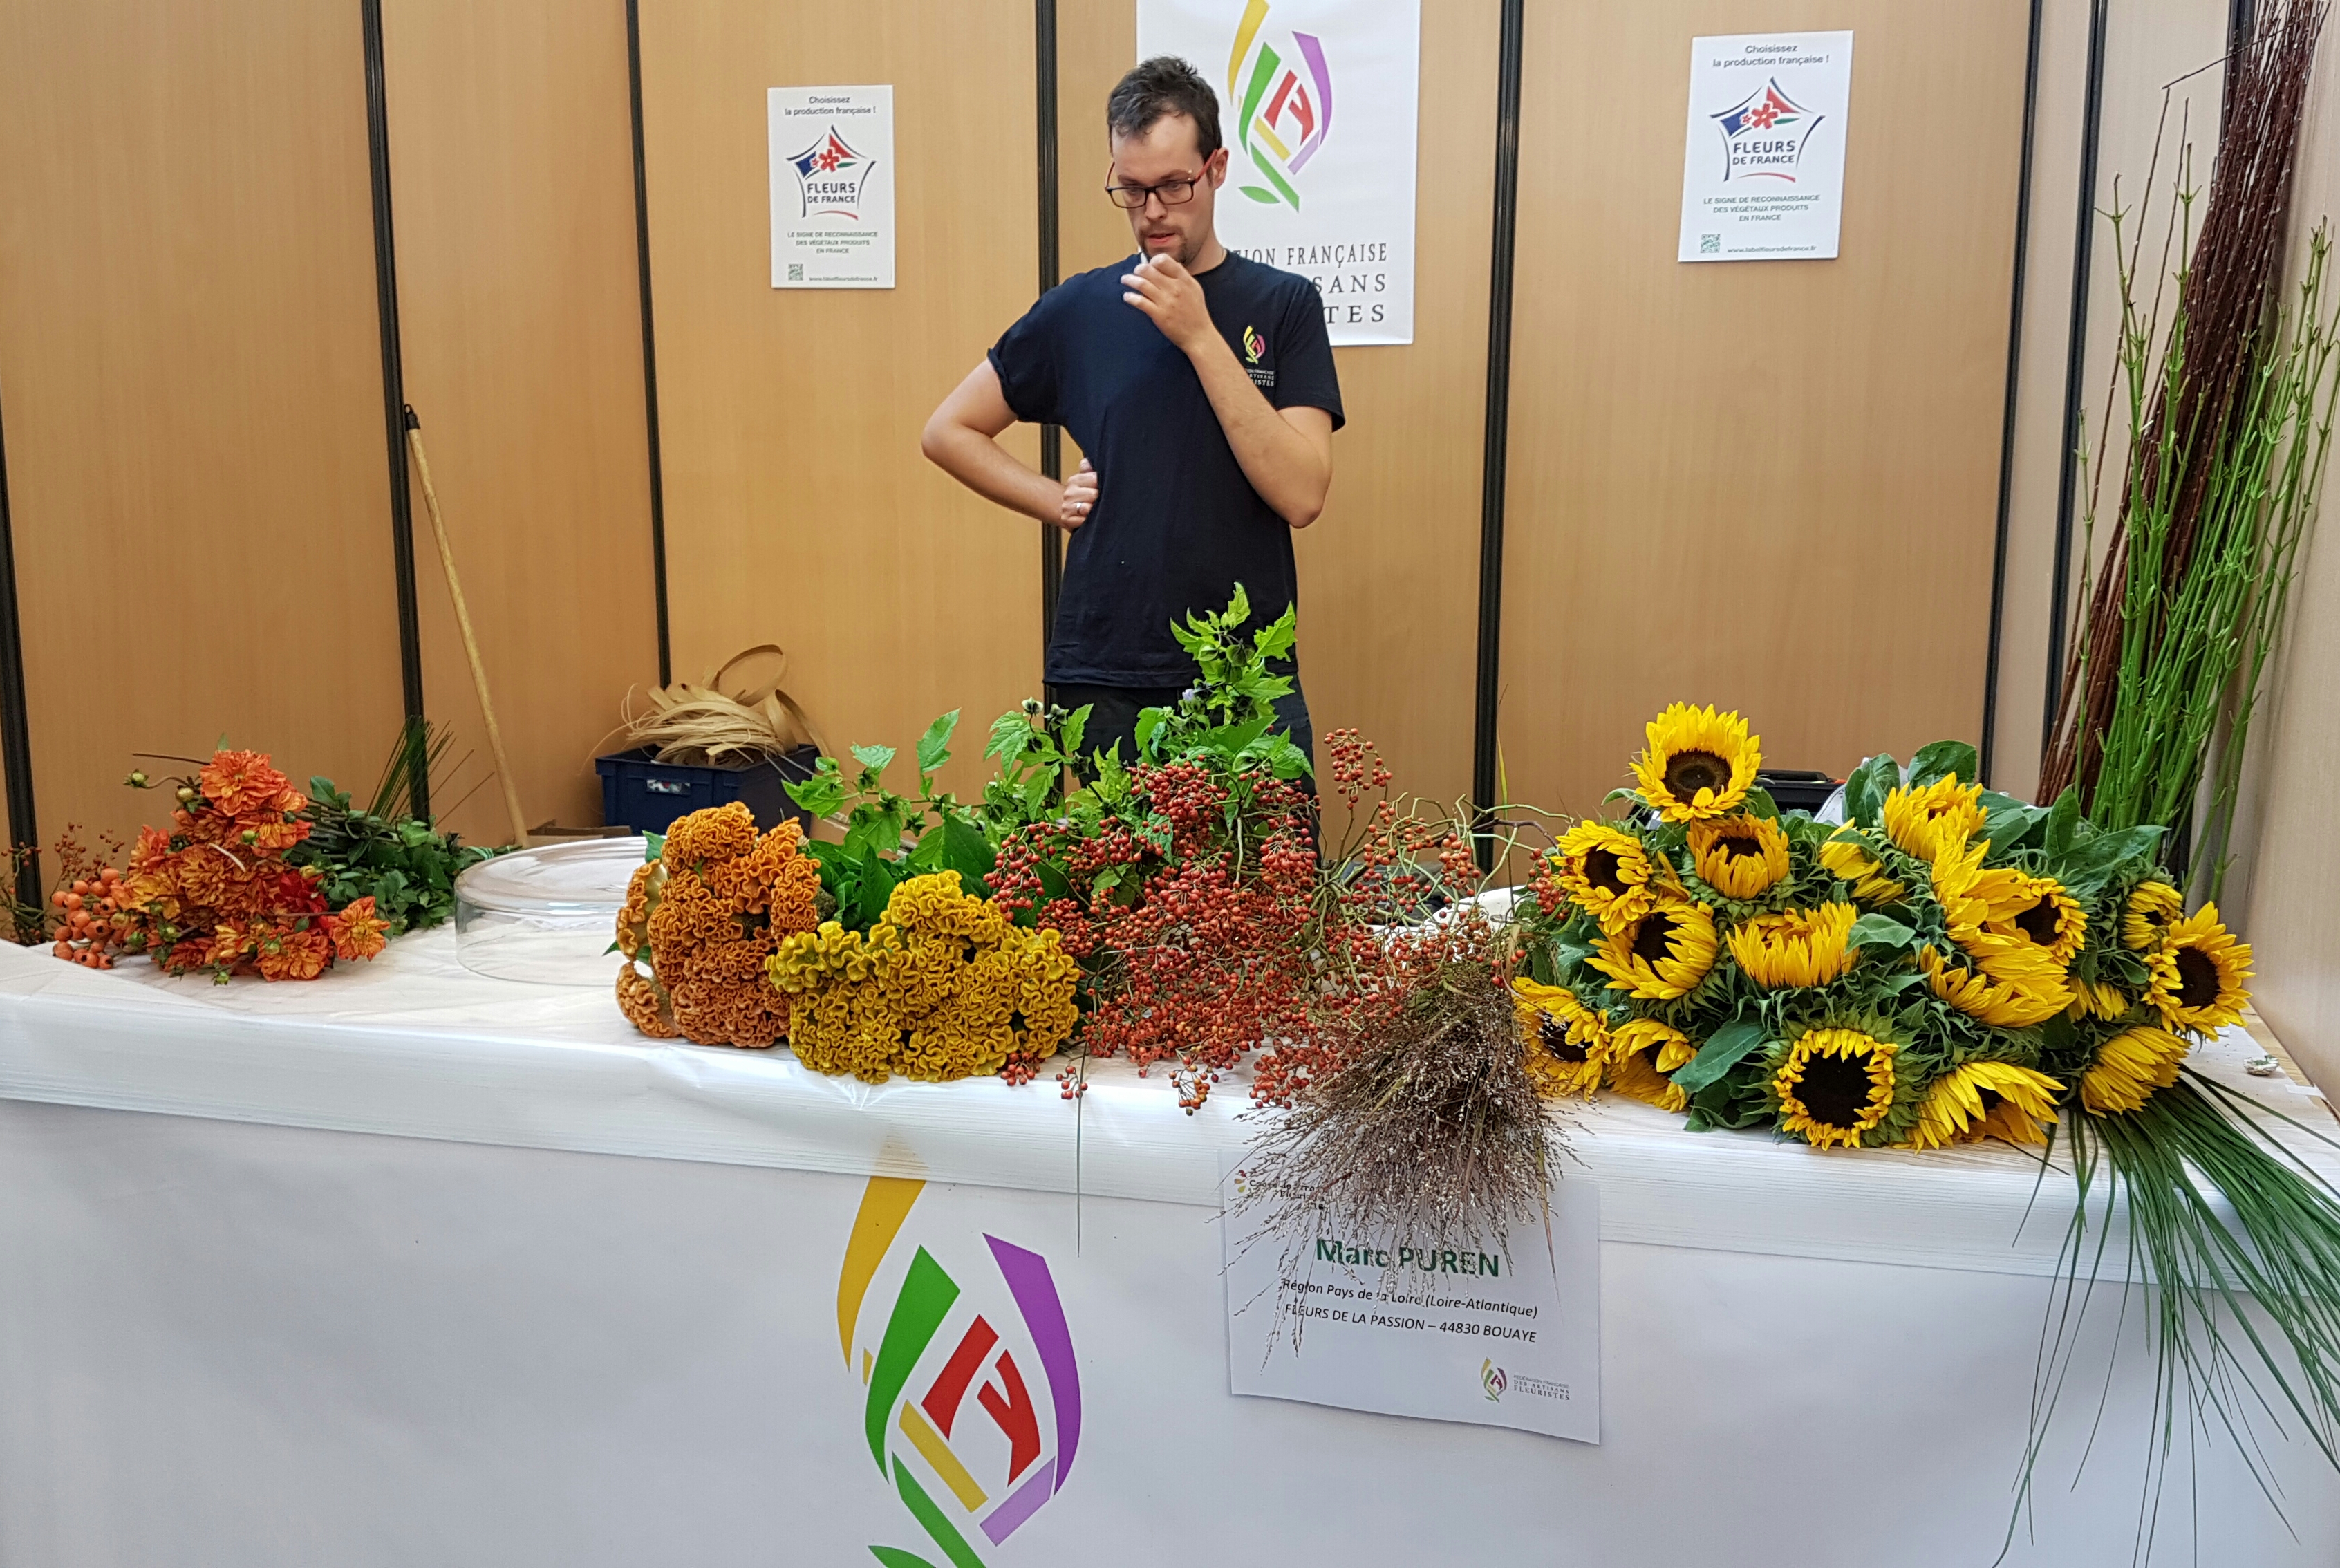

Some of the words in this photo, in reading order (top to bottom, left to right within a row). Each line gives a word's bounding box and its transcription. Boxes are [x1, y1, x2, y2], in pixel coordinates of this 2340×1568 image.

[1745, 44, 1798, 53] Choisissez
[1712, 59, 1721, 67] la
[1723, 57, 1776, 68] production
[1779, 55, 1823, 66] française
[794, 108, 834, 117] production
[836, 106, 871, 115] française
[1733, 140, 1795, 153] FLEURS
[1732, 156, 1747, 165] DE
[1750, 155, 1795, 164] FRANCE
[807, 183, 855, 194] FLEURS
[821, 195, 855, 203] FRANCE
[1751, 194, 1820, 203] RECONNAISSANCE
[1287, 243, 1387, 268] FRANÇAISE
[1316, 1238, 1389, 1267] Marc
[1399, 1247, 1499, 1278] PUREN
[1327, 1285, 1354, 1299] Pays
[1358, 1289, 1373, 1300] de
[1425, 1294, 1537, 1319] (Loire-Atlantique)
[1332, 1310, 1348, 1322] DE
[1352, 1313, 1366, 1324] LA
[1370, 1315, 1425, 1330] PASSION
[1439, 1322, 1480, 1335] 44830
[1483, 1325, 1537, 1343] BOUAYE
[1514, 1385, 1570, 1401] FLEURISTES
[1532, 1383, 1569, 1394] ARTISANS
